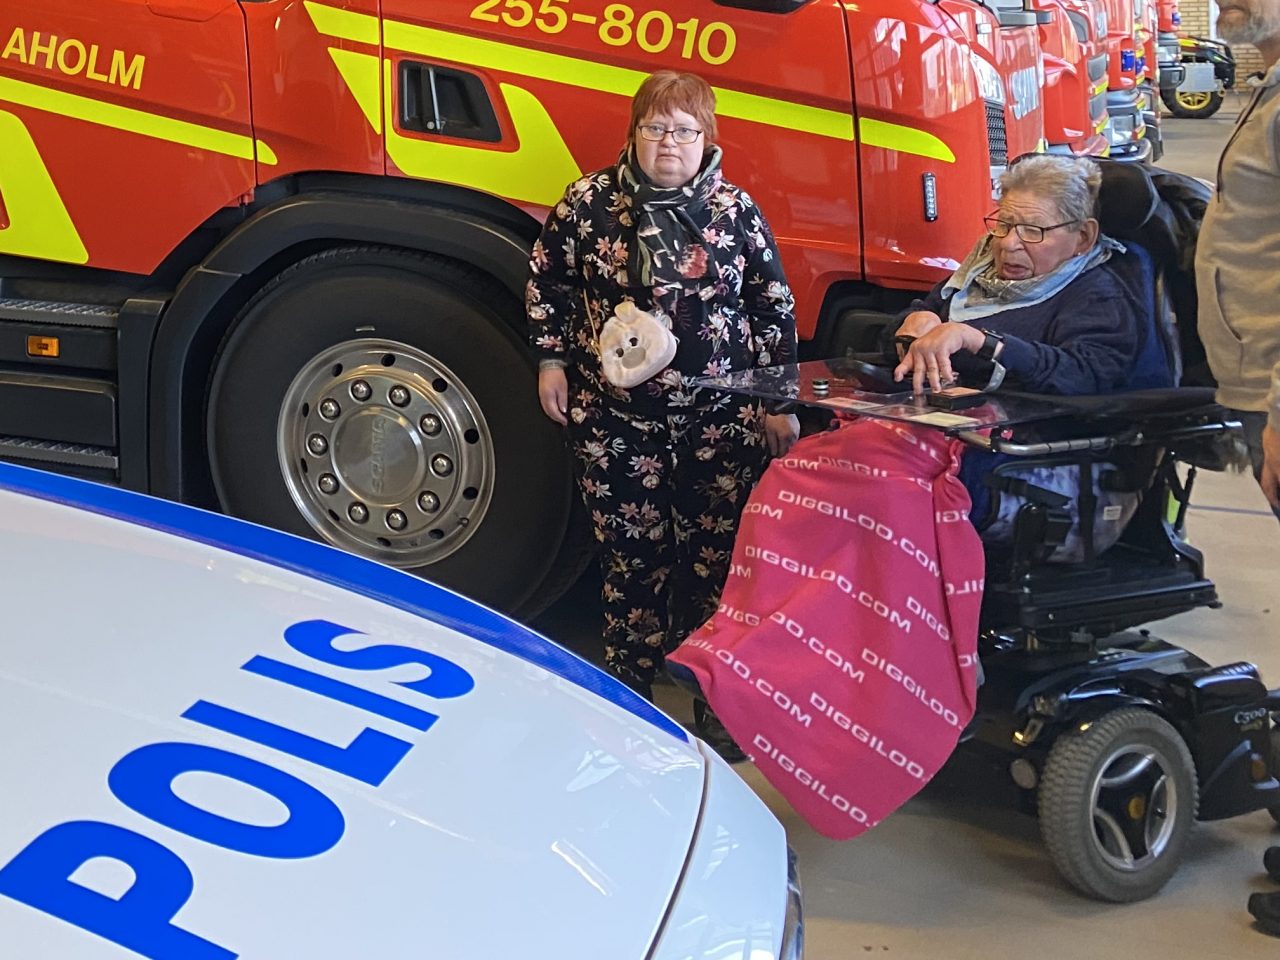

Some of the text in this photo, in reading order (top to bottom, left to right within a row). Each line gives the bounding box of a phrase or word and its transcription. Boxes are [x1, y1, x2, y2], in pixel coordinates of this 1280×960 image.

[745, 545, 912, 634] DIGGILOO.COM
[753, 734, 879, 828] DIGGILOO.
[810, 692, 935, 782] DIGGILOO.
